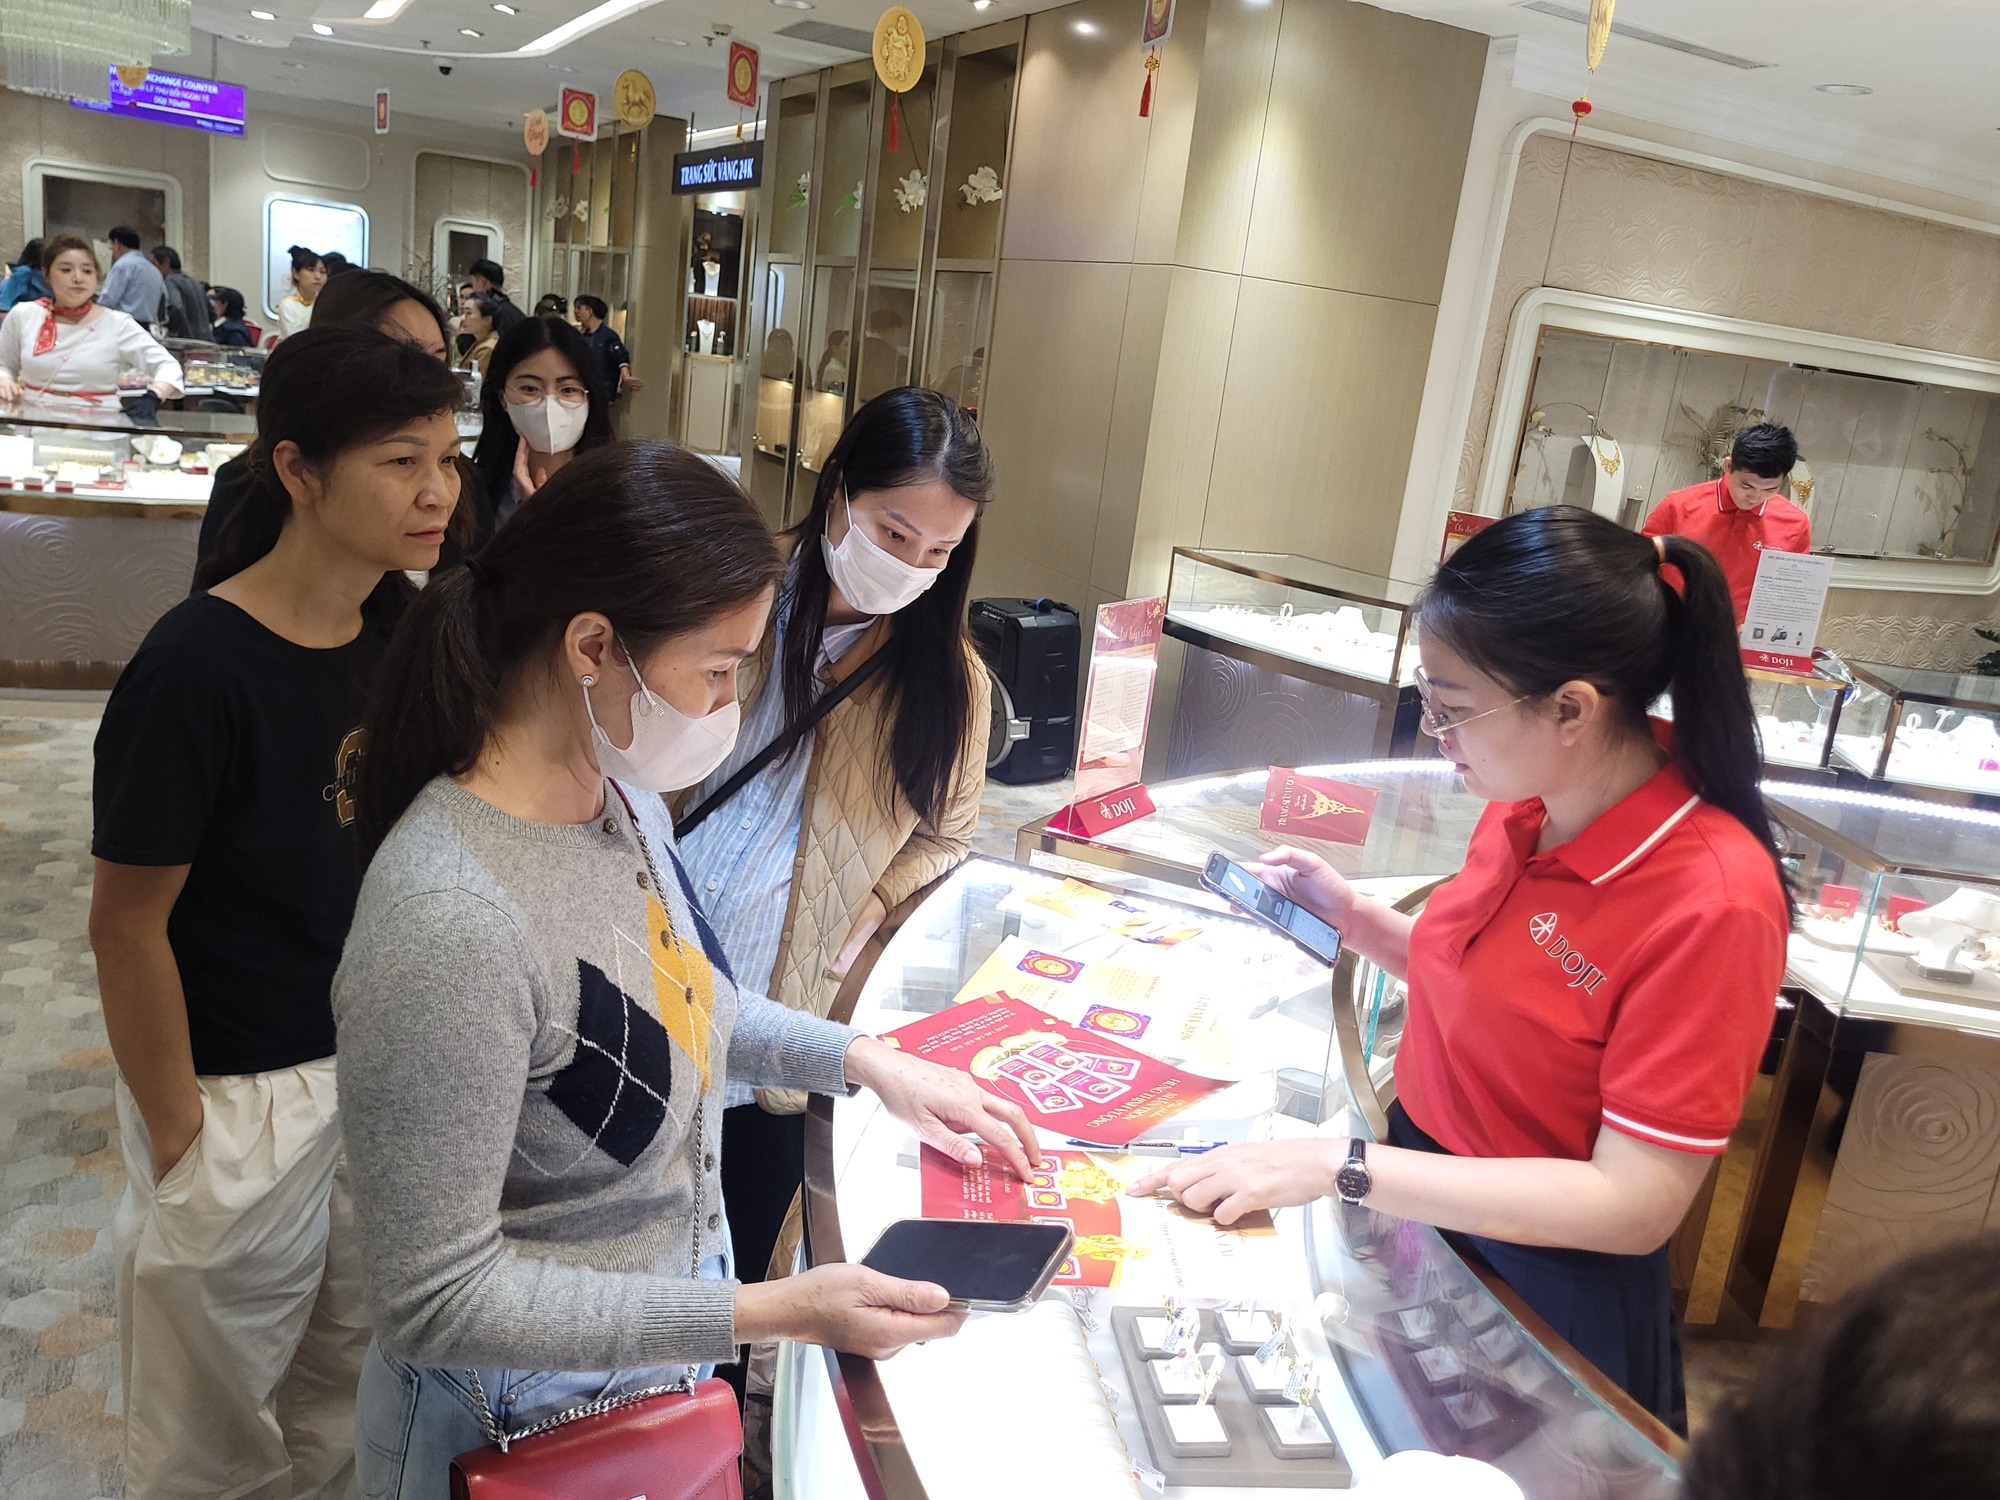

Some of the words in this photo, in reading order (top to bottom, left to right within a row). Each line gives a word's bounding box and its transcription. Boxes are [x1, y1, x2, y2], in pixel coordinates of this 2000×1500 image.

[146, 74, 182, 87] XCHANGE
[182, 79, 218, 94] COUNTER
[681, 164, 703, 186] TRANG
[703, 158, 717, 183] SỨC
[718, 156, 738, 182] VÀNG
[738, 157, 754, 180] 24K
[1772, 656, 1794, 667] DOJI
[1111, 797, 1138, 817] DOJI
[1545, 934, 1606, 996] DOJI
